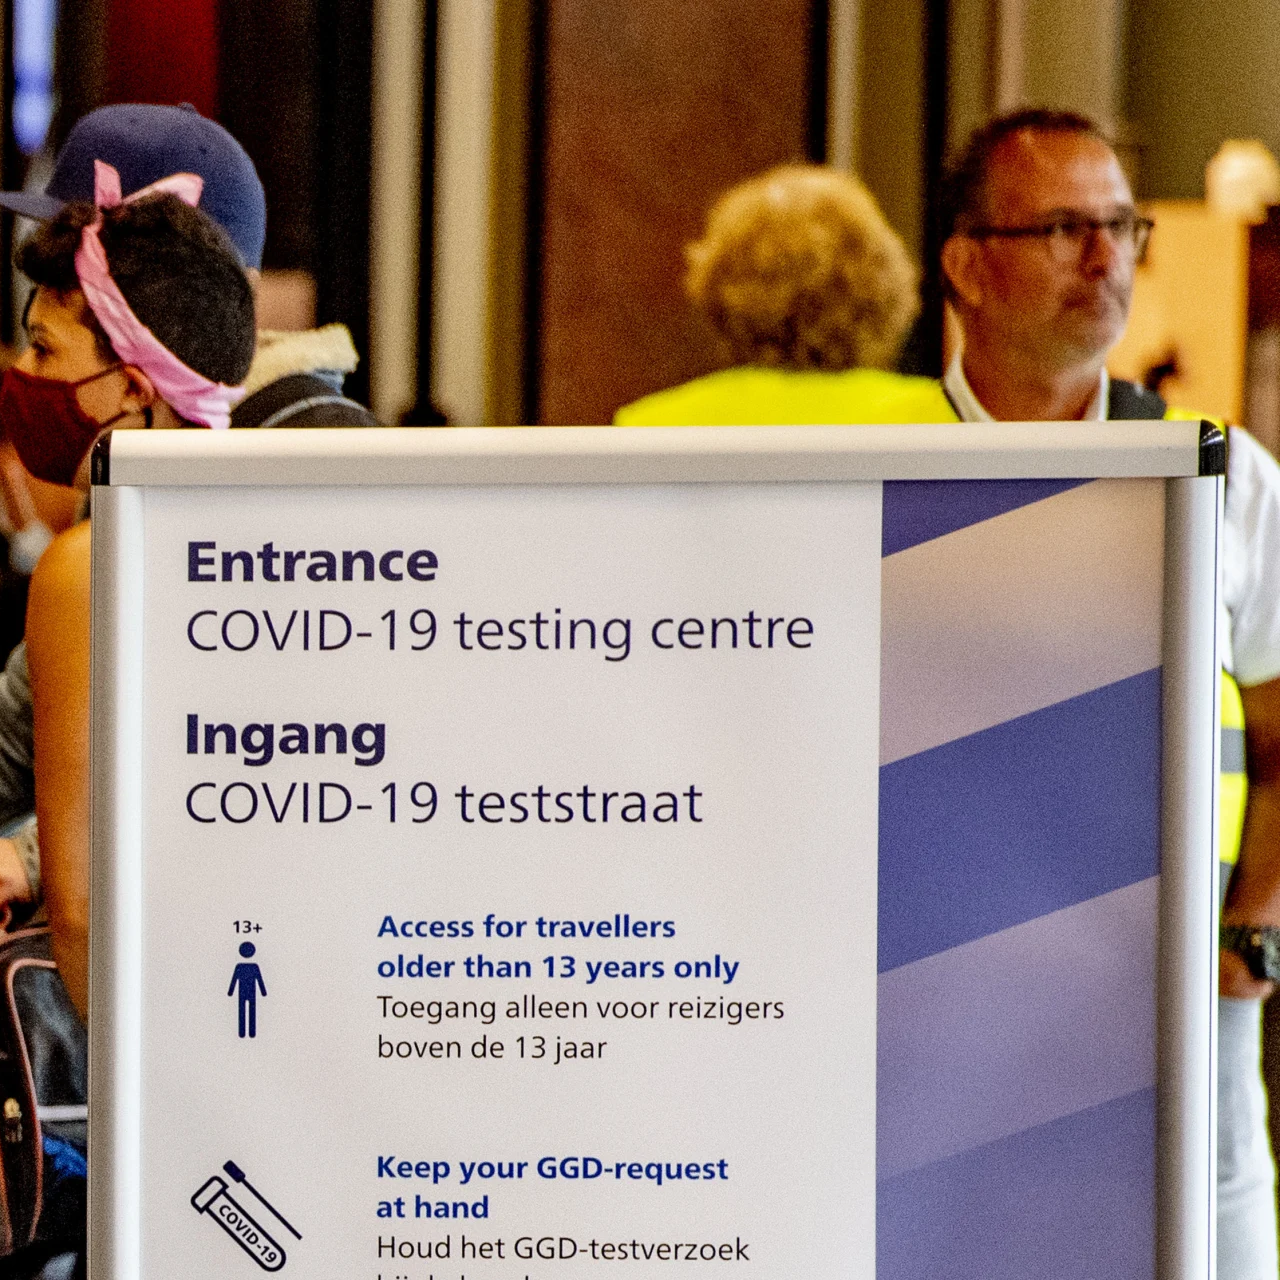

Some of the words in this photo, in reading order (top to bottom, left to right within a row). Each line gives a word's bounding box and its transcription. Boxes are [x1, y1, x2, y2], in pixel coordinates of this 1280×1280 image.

[187, 541, 439, 583] Entrance
[186, 608, 437, 651] COVID-19
[453, 608, 631, 662] testing
[651, 610, 814, 650] centre
[186, 713, 386, 767] Ingang
[185, 781, 438, 824] COVID-19
[454, 784, 703, 823] teststraat
[232, 920, 263, 934] 13+
[377, 915, 475, 938] Access
[482, 913, 528, 938] for
[535, 913, 676, 939] travellers
[377, 953, 456, 979] older
[463, 953, 532, 978] than
[542, 955, 576, 979] 13
[585, 960, 665, 985] years
[673, 954, 740, 984] only
[376, 995, 496, 1025] Toegang
[505, 993, 588, 1019] alleen
[596, 1001, 660, 1019] voor
[668, 995, 785, 1025] reizigers
[378, 1033, 462, 1059] boven
[470, 1033, 505, 1059] de
[516, 1035, 546, 1059] 13
[553, 1035, 608, 1066] jaar
[377, 1155, 451, 1185] Keep
[459, 1161, 529, 1185] your
[536, 1156, 729, 1186] GGD-request
[376, 1197, 406, 1219] at
[414, 1194, 489, 1219] hand
[218, 1204, 277, 1263] COVID-19
[377, 1234, 451, 1260] Houd
[461, 1234, 506, 1260] het
[513, 1236, 750, 1262] GGD-testverzoek
